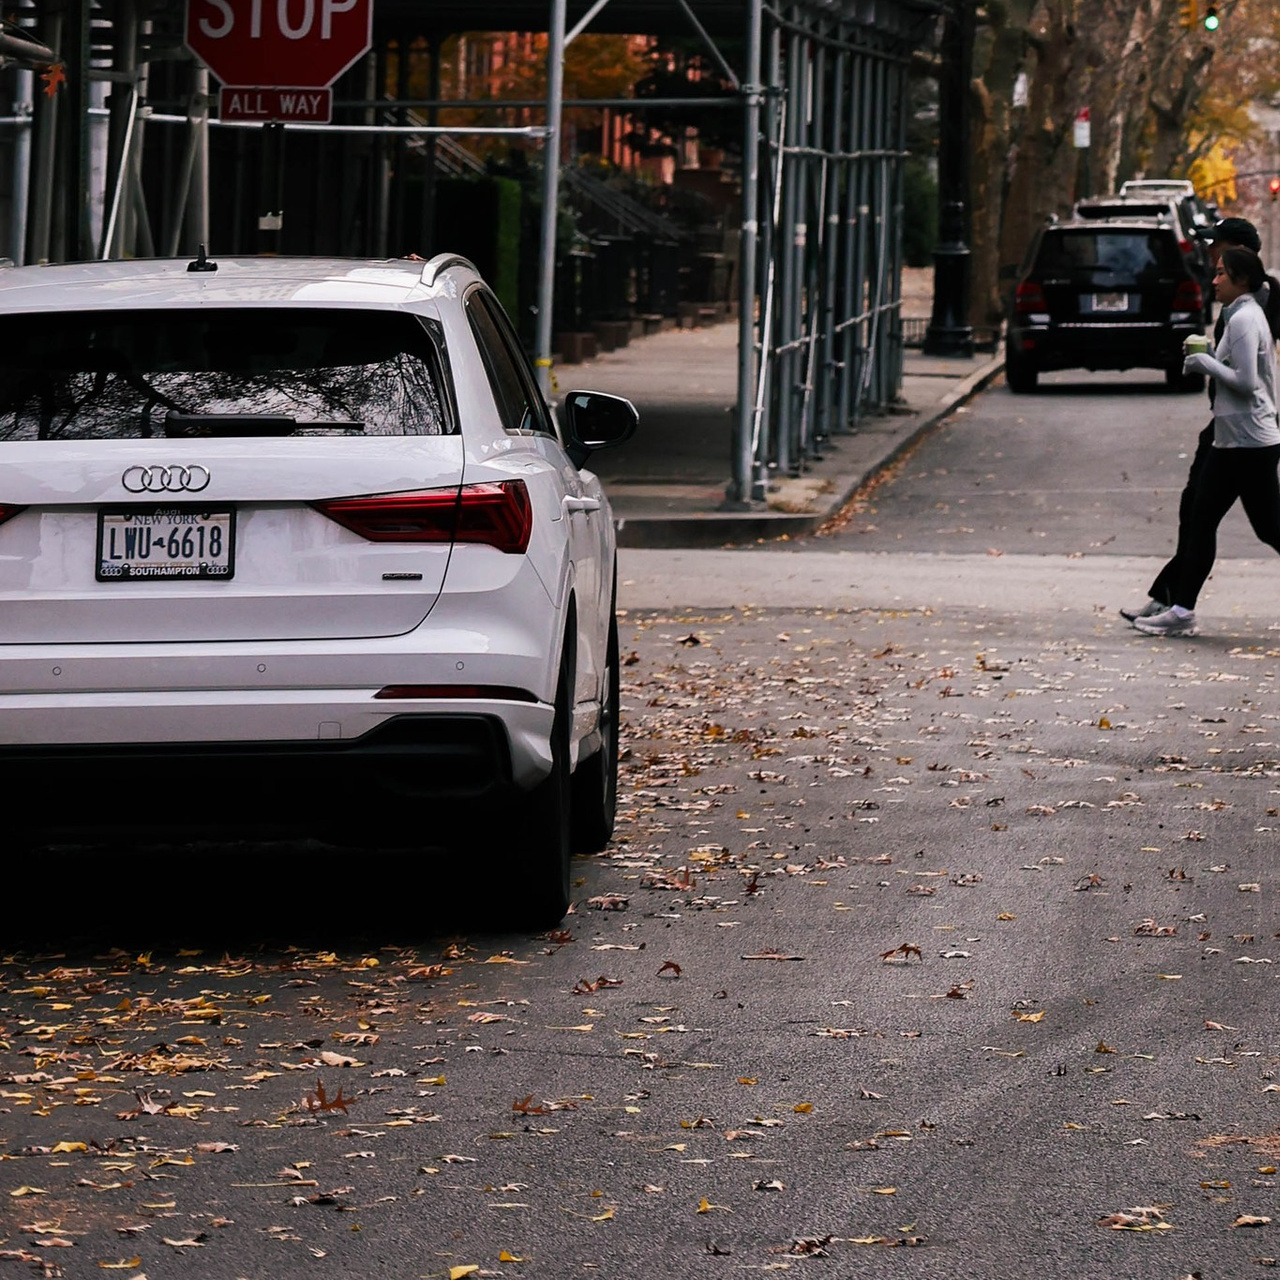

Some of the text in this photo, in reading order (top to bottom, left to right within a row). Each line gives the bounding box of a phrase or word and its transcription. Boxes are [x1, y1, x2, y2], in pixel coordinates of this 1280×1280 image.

[228, 94, 322, 115] ALL WAY
[134, 514, 199, 525] NEW YORK
[129, 566, 200, 576] SOUTHAMPTON
